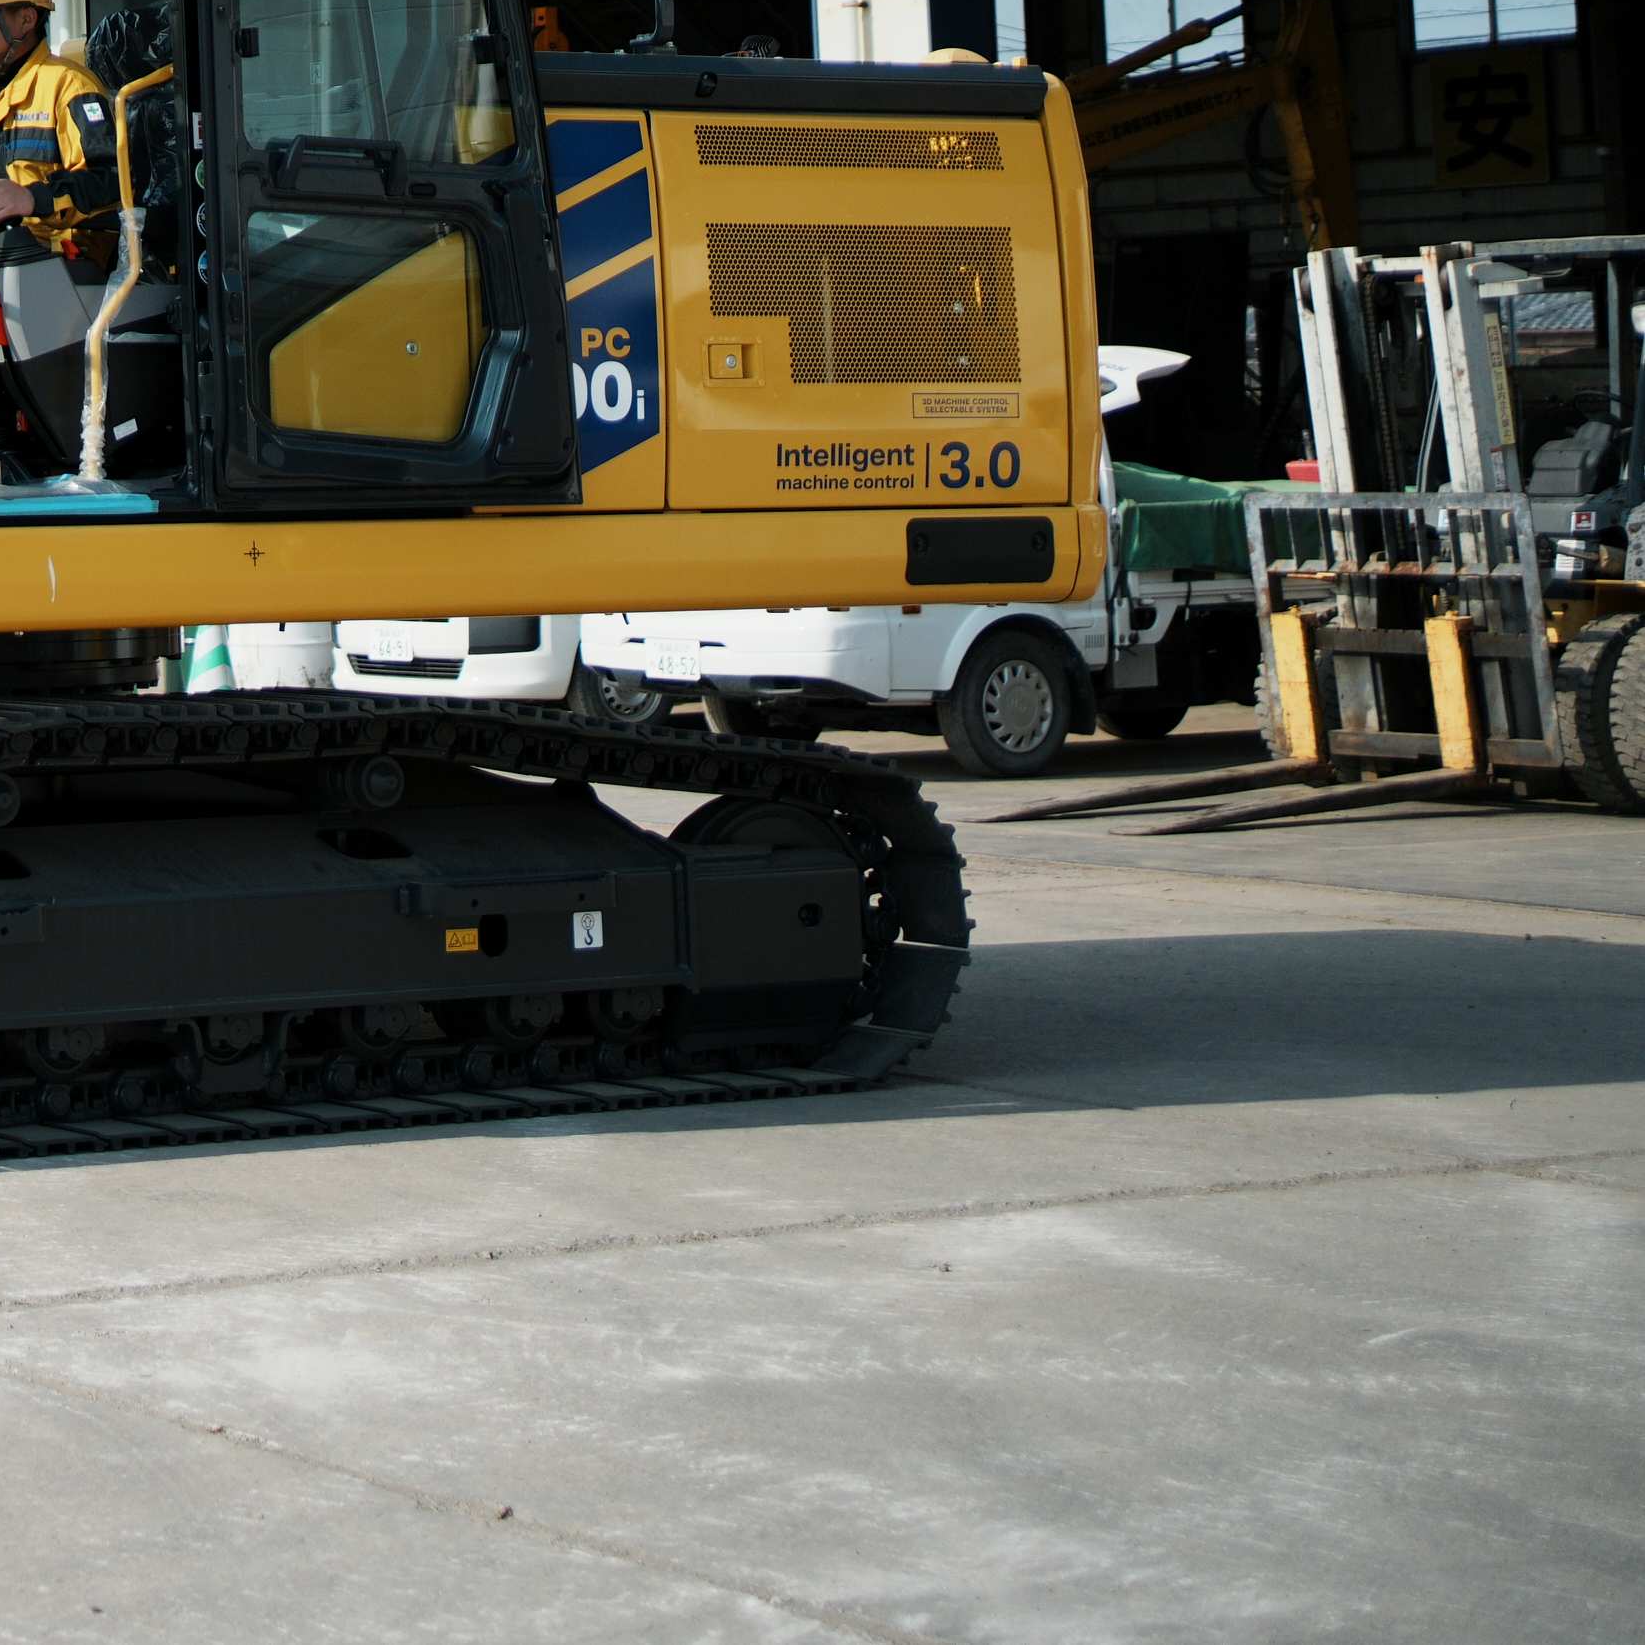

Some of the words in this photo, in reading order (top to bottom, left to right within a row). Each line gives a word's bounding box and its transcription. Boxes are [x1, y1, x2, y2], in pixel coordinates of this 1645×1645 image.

[1445, 64, 1532, 172] 安
[581, 326, 631, 358] PC
[776, 443, 915, 472] Intelligent
[939, 441, 1021, 489] 3.0
[776, 474, 849, 490] machine
[853, 474, 915, 490] control
